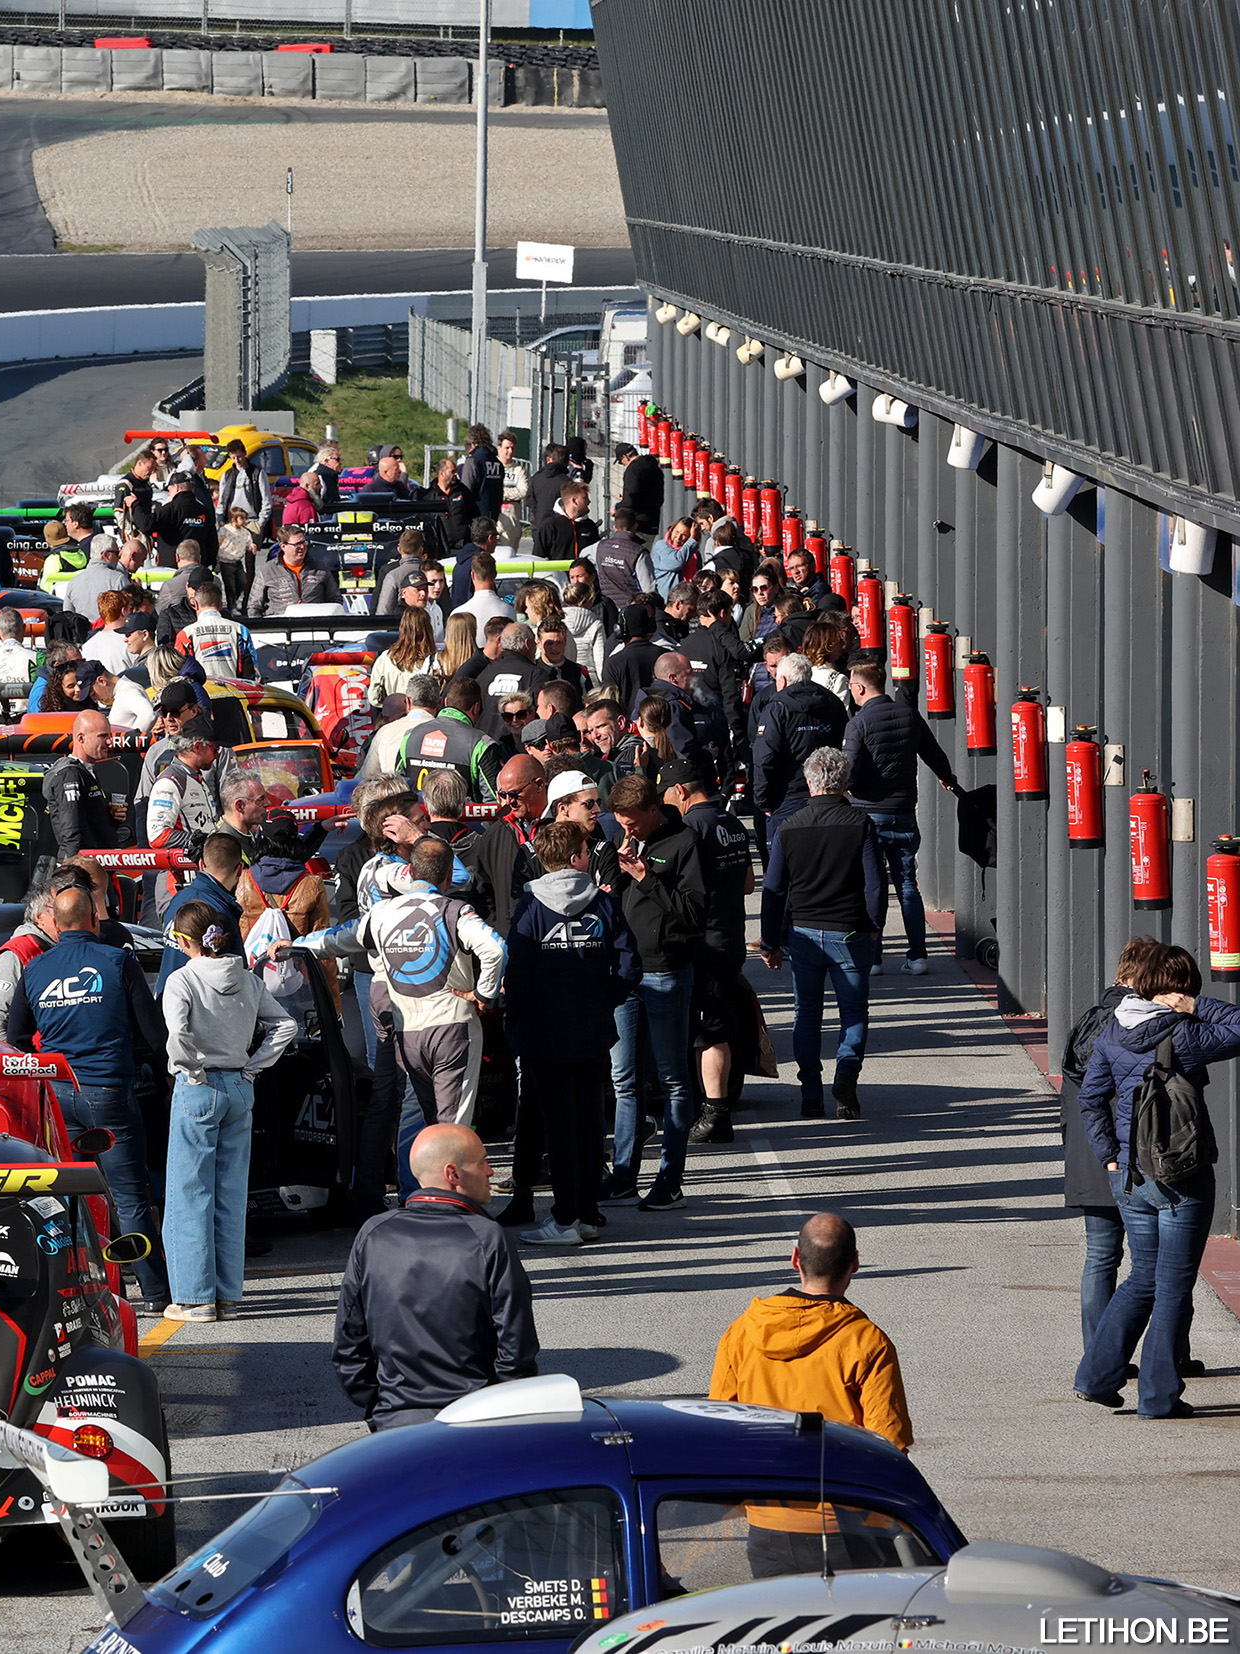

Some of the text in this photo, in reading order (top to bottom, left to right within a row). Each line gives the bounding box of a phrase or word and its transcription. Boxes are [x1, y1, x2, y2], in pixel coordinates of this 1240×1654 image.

[324, 522, 342, 533] sud
[372, 522, 424, 532] Belgo sud
[132, 735, 148, 748] IT
[465, 803, 498, 818] LEFT
[123, 853, 157, 866] RIGHT
[385, 946, 434, 954] MOTORSPORT
[541, 940, 603, 950] MOTORSPORT
[38, 995, 103, 1009] MOTORSPORT
[4, 1053, 39, 1068] torfs
[4, 1064, 56, 1076] compact
[28, 1367, 57, 1388] CAPPAL
[64, 1374, 117, 1388] POMAC
[54, 1393, 118, 1409] HEUNINCK
[201, 1552, 230, 1578] Club
[524, 1578, 585, 1595] SMETS D.
[507, 1593, 586, 1609] VERBEKE M.
[500, 1608, 587, 1625] DESCAMPS O.
[791, 1641, 834, 1652] Louis
[836, 1638, 896, 1651] Mazuin
[913, 1639, 983, 1652] Michaël
